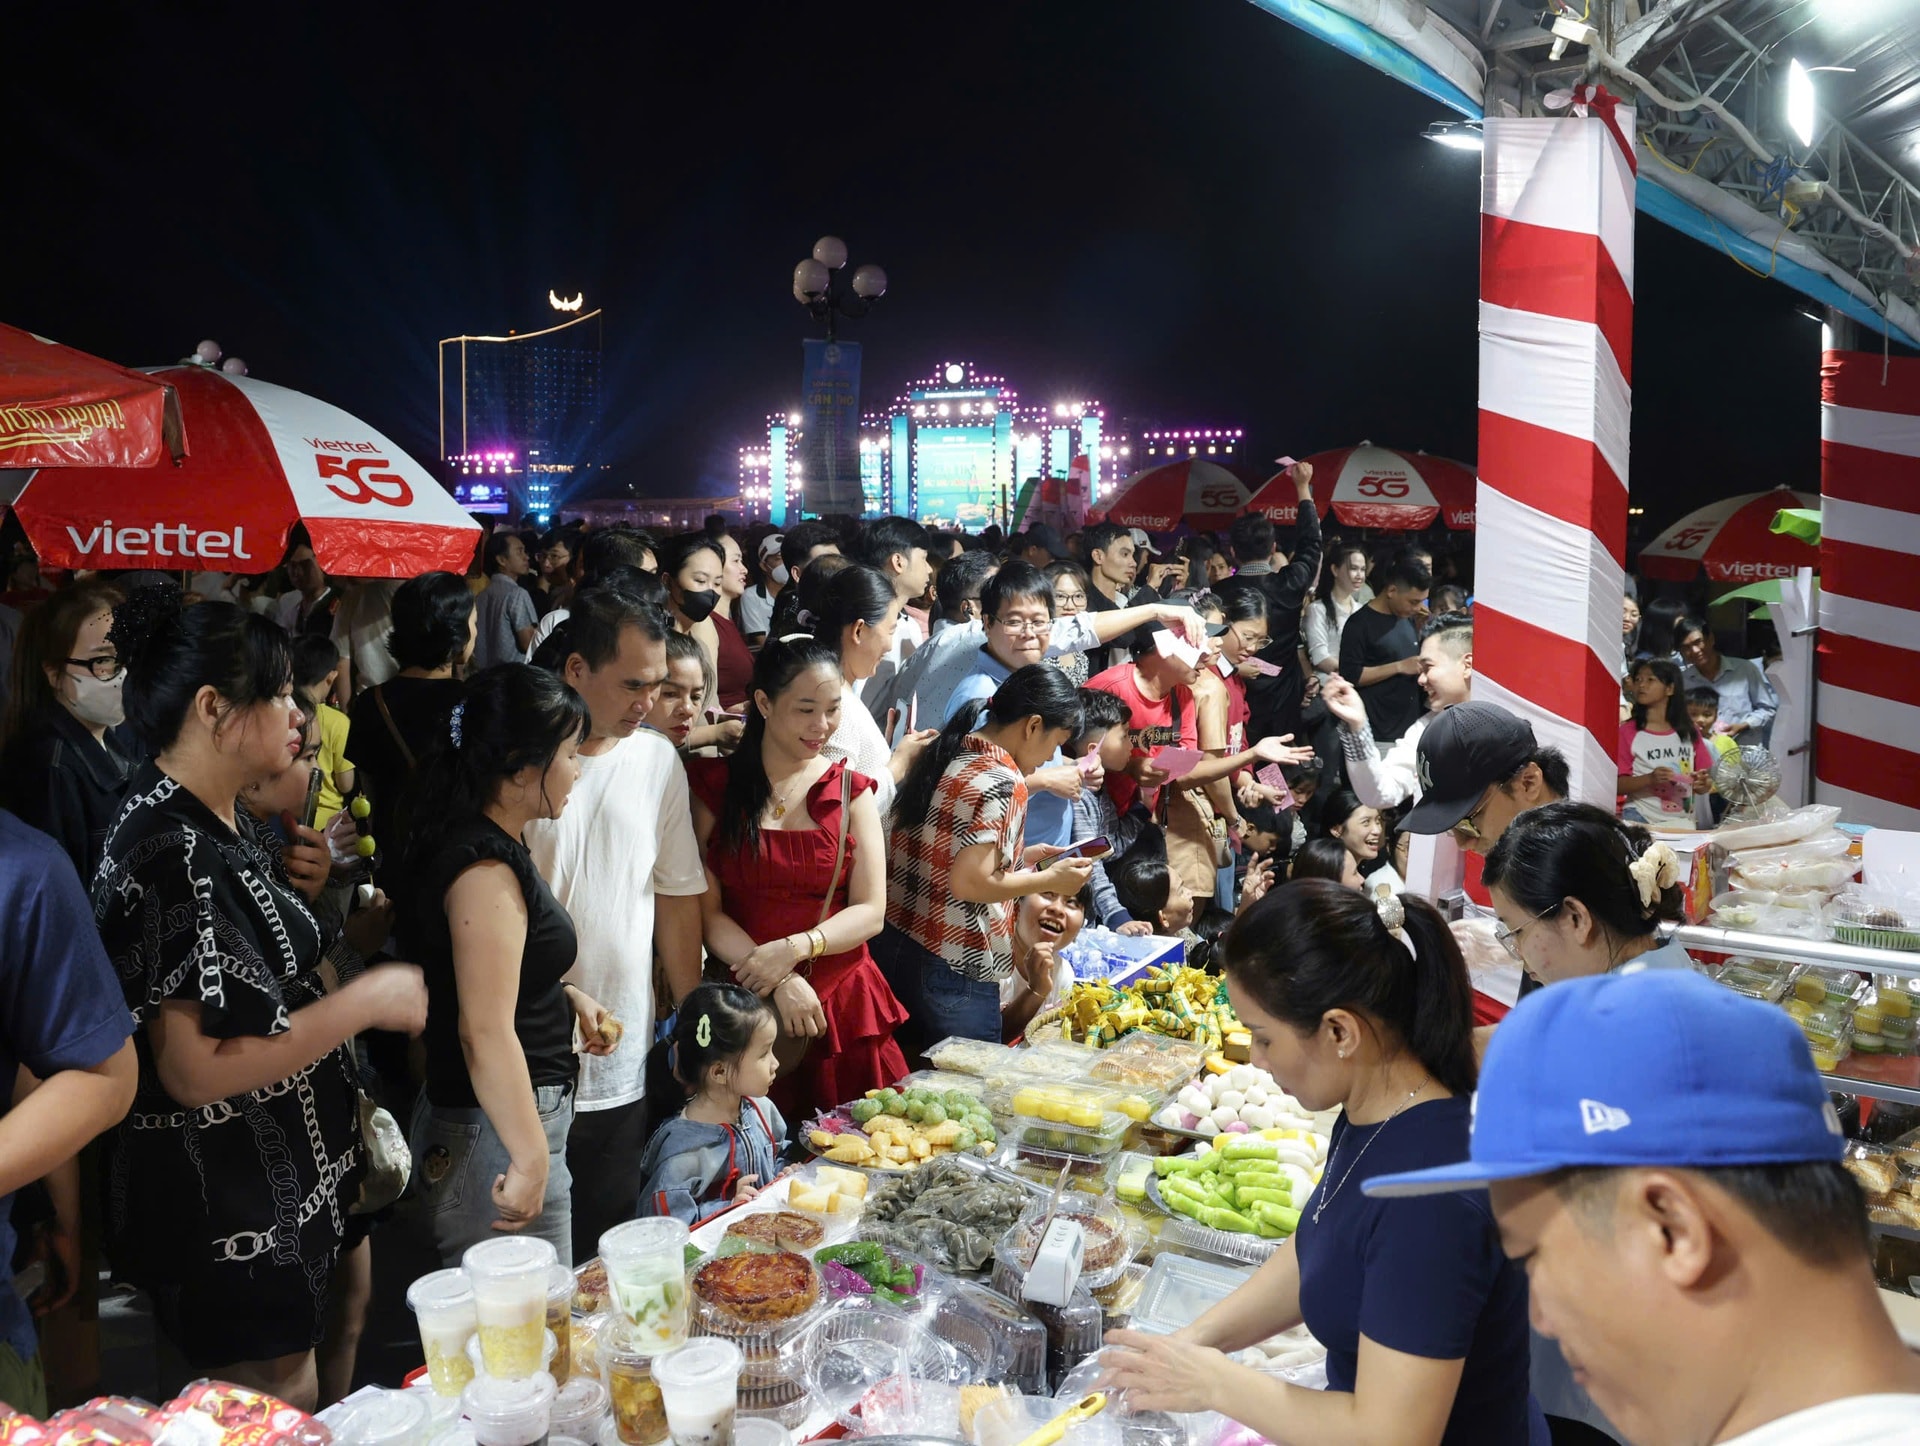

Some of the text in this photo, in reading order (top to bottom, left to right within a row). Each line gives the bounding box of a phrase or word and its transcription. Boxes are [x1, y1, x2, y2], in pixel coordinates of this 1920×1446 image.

[54, 399, 125, 436] ngon!
[303, 437, 382, 453] viettel
[315, 453, 414, 507] 5G
[1358, 476, 1410, 498] 5G
[1201, 489, 1241, 508] 5G
[1120, 514, 1170, 527] viettel
[65, 519, 252, 560] viettel
[1664, 527, 1712, 550] 5G
[1720, 561, 1796, 578] viettel
